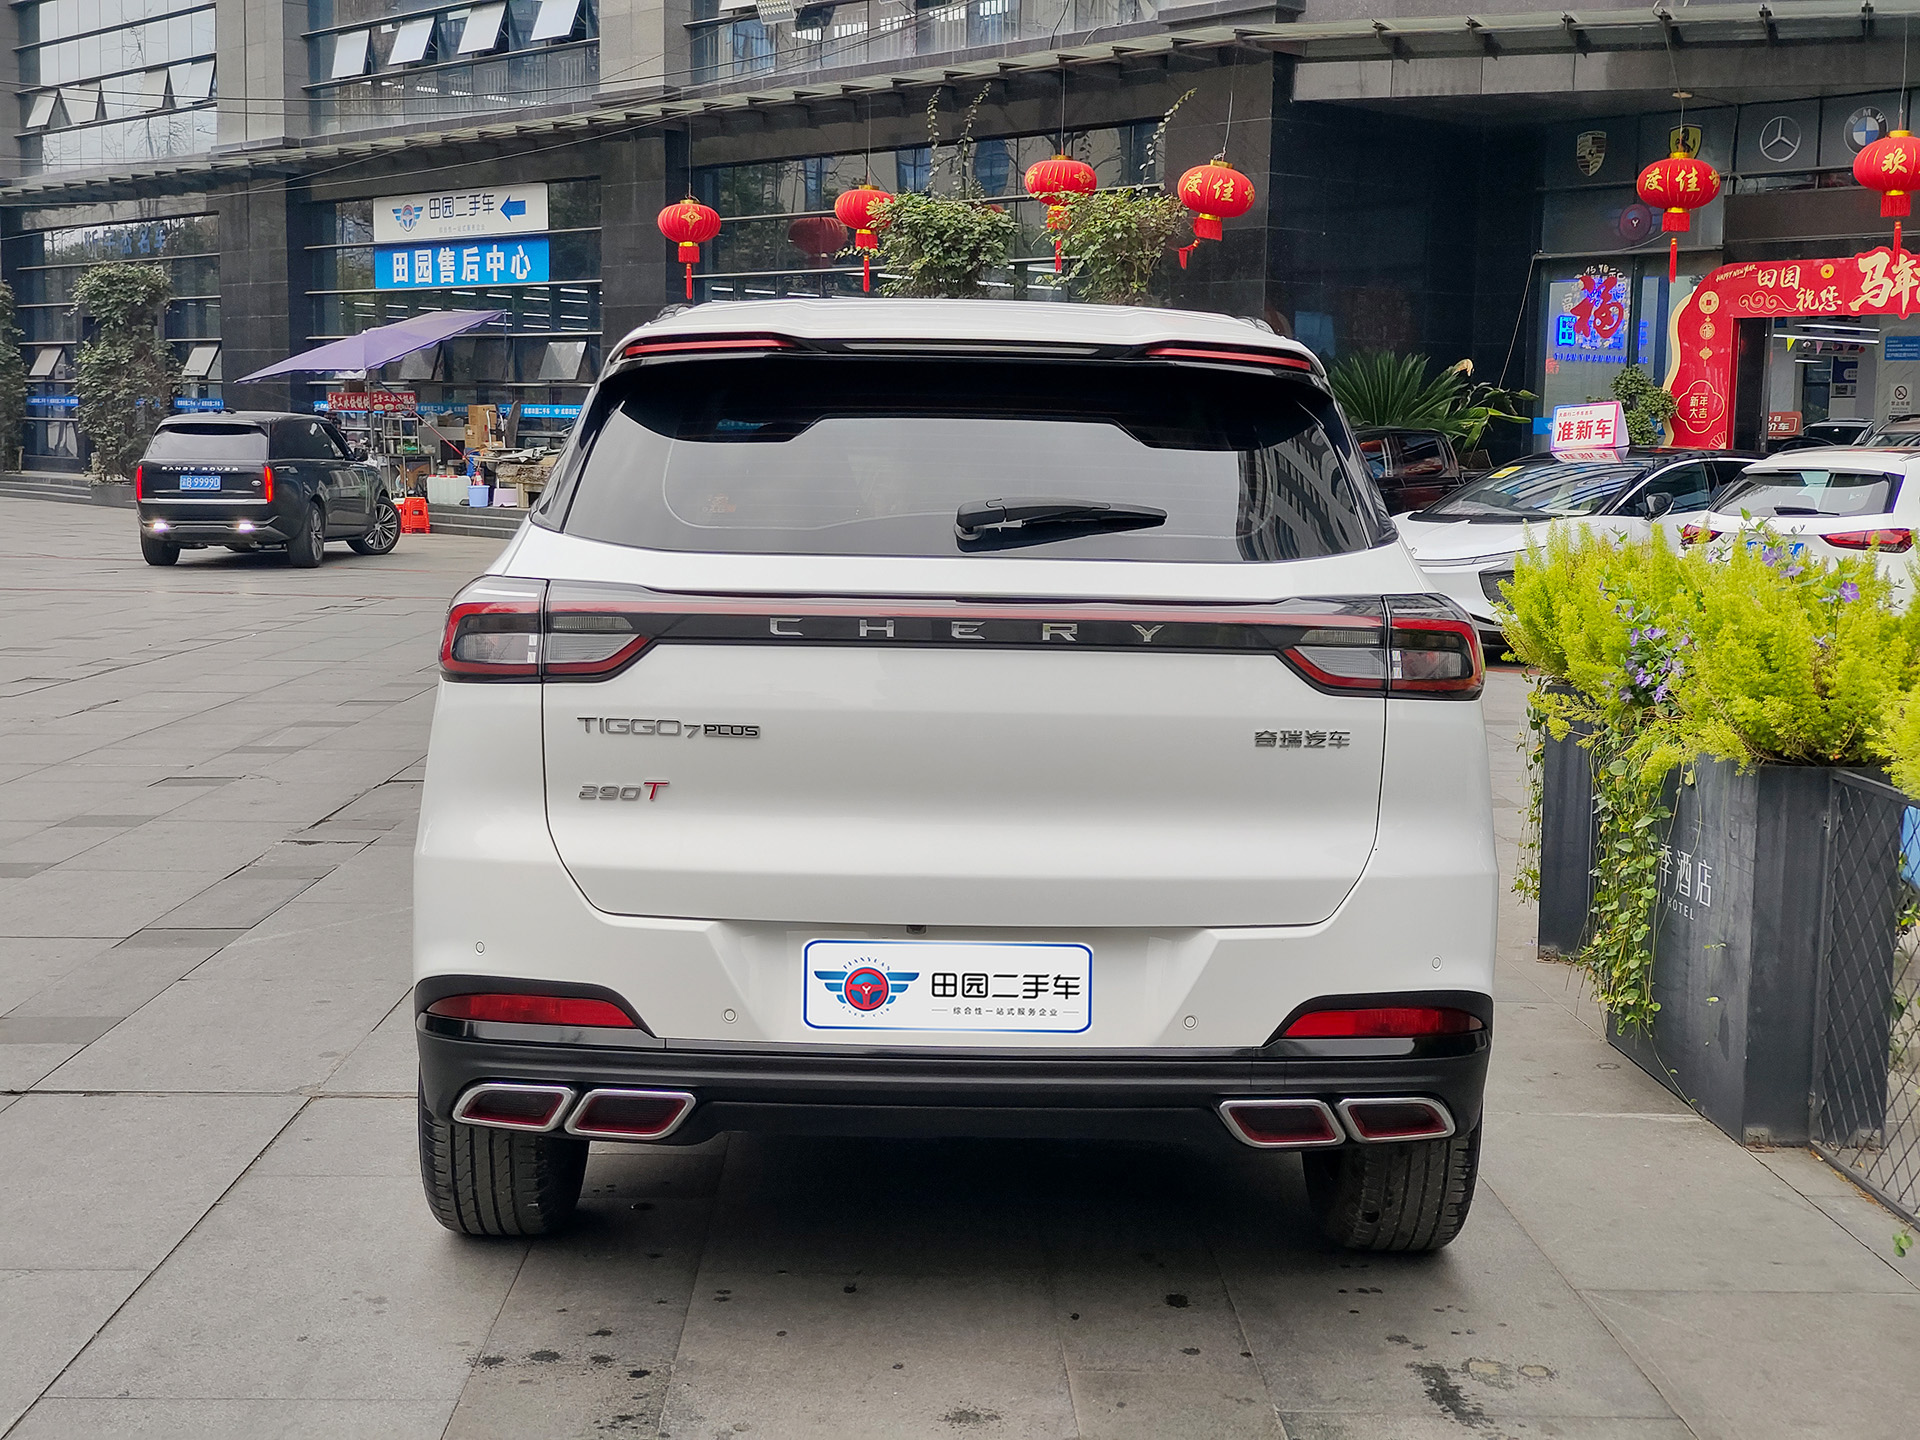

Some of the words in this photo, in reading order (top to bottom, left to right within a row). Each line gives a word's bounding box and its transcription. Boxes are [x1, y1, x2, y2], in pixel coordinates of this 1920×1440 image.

[1850, 108, 1886, 124] BMW
[1881, 147, 1908, 174] 欢
[428, 193, 495, 220] 田园二手车
[392, 244, 532, 284] 田园售后中心
[1758, 265, 1800, 288] 田园
[1848, 252, 1920, 314] 马年
[1795, 285, 1842, 311] 祝您
[1690, 396, 1708, 407] 新年
[1689, 408, 1707, 419] 大吉
[1557, 419, 1612, 441] 准新车
[769, 617, 1165, 643] CHERY
[703, 724, 760, 738] PLUS
[1254, 730, 1351, 749] 奇瑞汽车
[579, 780, 670, 801] 290T
[1658, 842, 1713, 908] 季酒店
[1667, 896, 1694, 920] HOTEL
[931, 972, 1081, 1000] 田园二手车
[952, 1006, 1058, 1017] 综合性一站式服务企业
